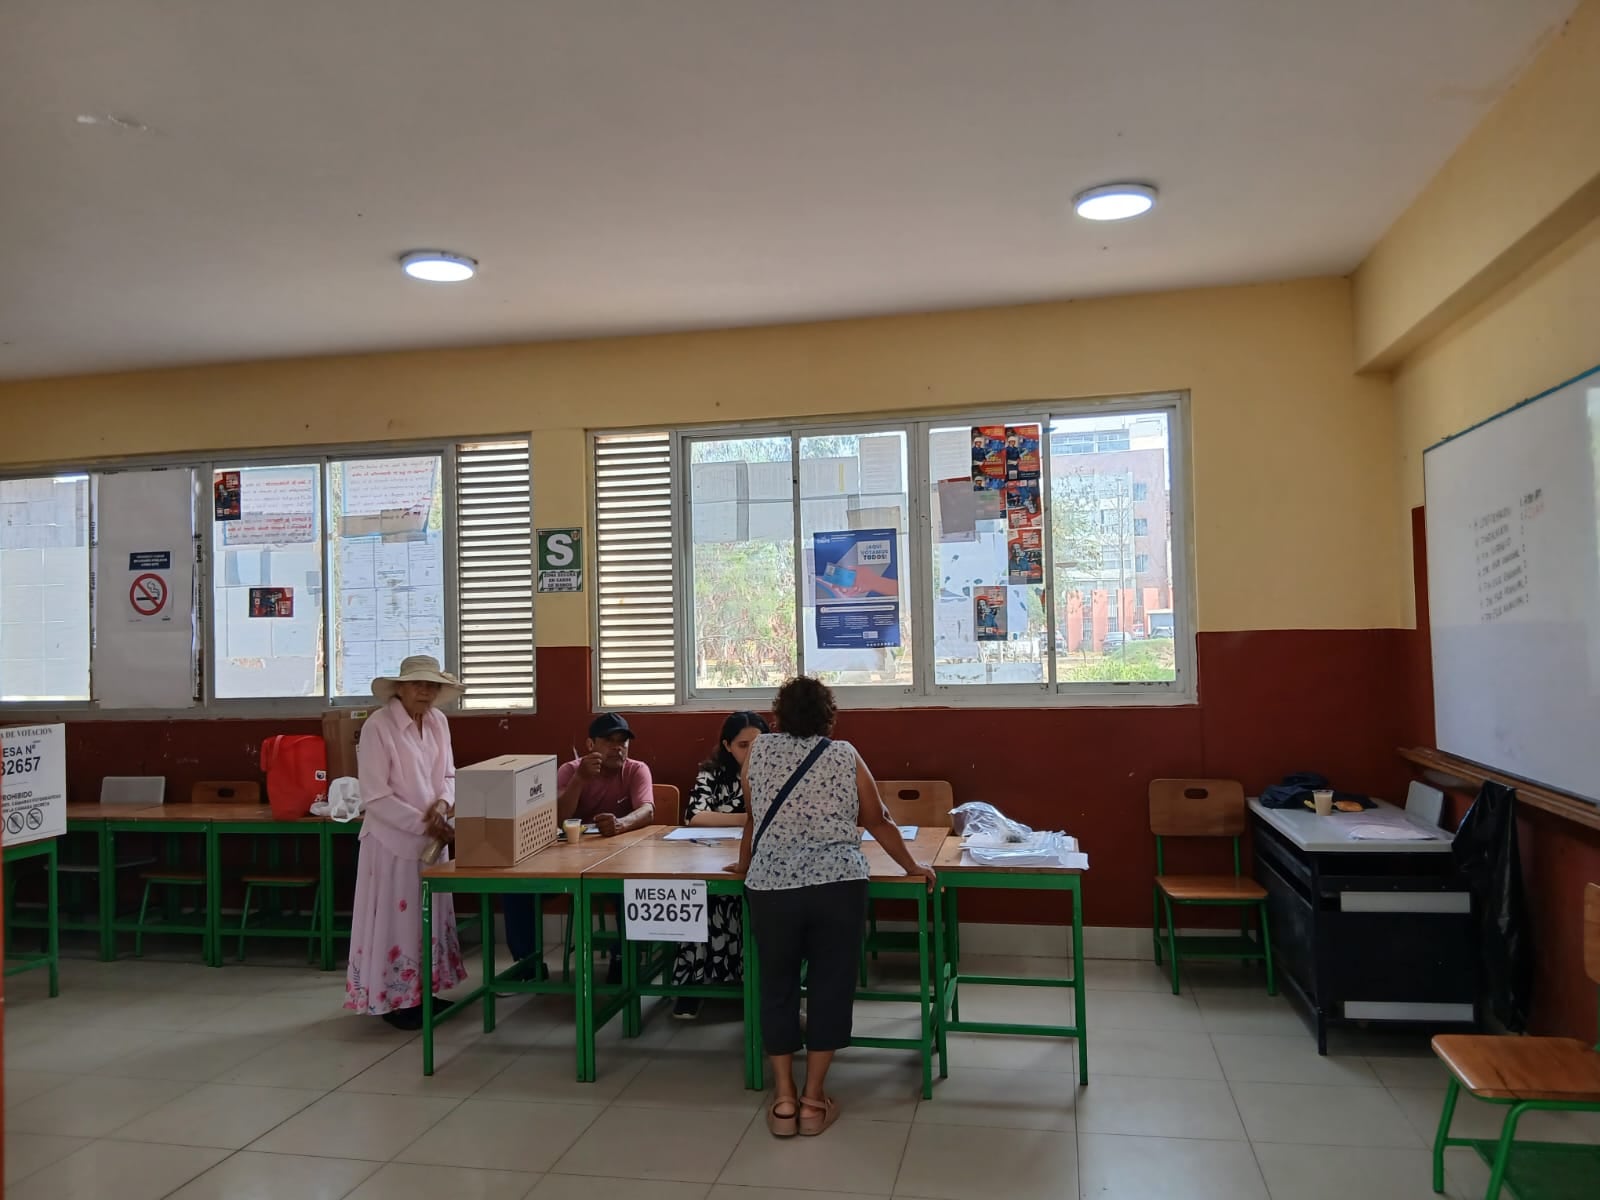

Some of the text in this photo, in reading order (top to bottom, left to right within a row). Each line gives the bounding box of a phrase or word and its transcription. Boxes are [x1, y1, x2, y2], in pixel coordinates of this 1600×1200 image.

[546, 533, 574, 566] S
[5, 731, 15, 739] DE
[2, 745, 23, 758] ESA
[1, 756, 41, 776] 32657
[2, 791, 33, 801] ROHIBIDO
[529, 783, 543, 797] ONPE
[635, 888, 677, 901] MESA
[627, 902, 704, 922] 032657
